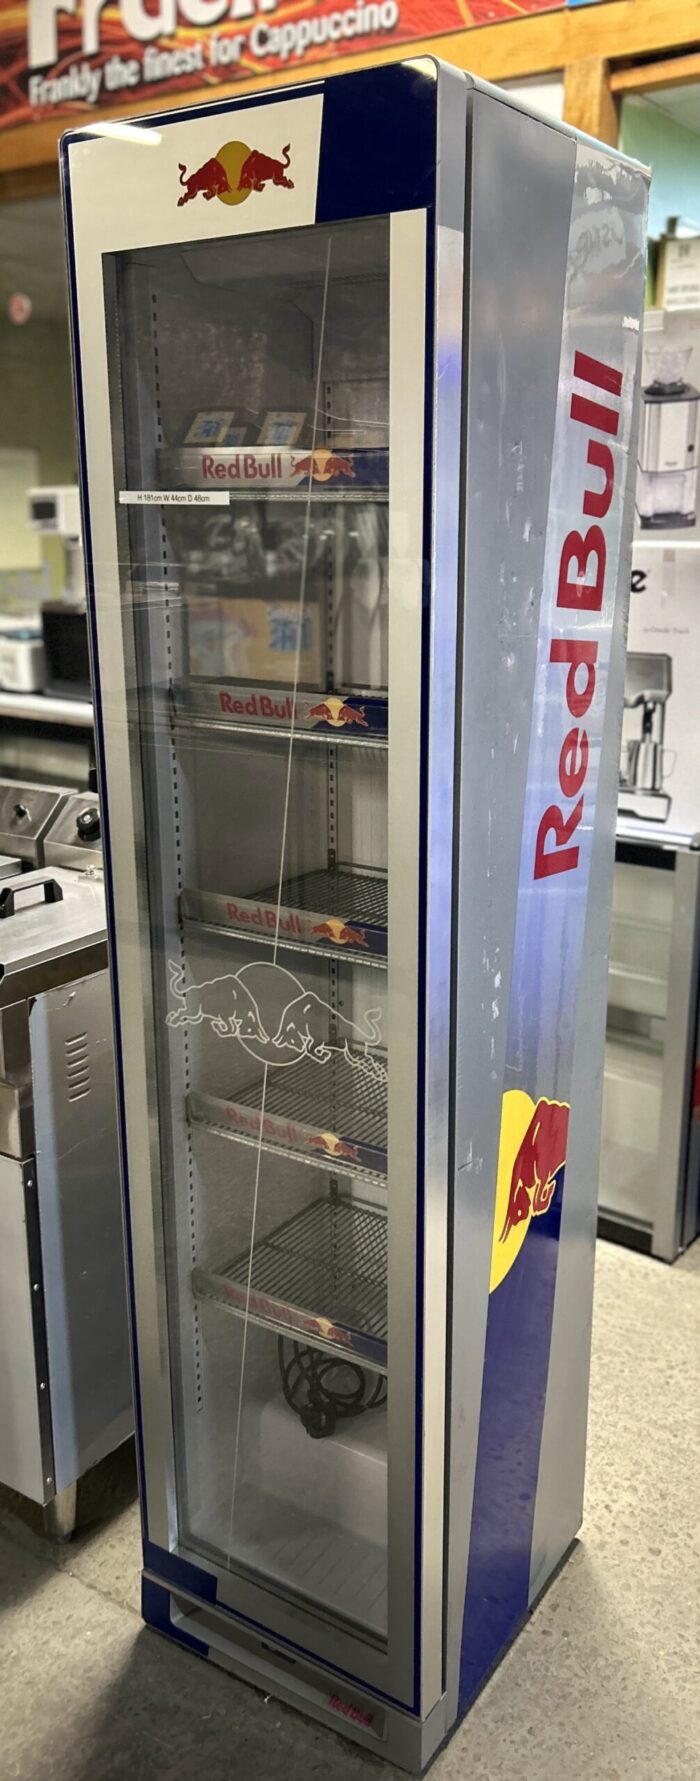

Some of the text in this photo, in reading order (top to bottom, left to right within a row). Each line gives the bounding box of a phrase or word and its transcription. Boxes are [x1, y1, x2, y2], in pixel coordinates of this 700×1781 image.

[28, 60, 102, 107] Frankly
[104, 54, 141, 91] the
[143, 43, 204, 82] finest
[209, 31, 245, 66] for
[250, 0, 398, 60] Cappuccino
[202, 452, 282, 479] Red Bull
[534, 350, 623, 880] Red Bull
[219, 692, 298, 719] Red Bull
[226, 902, 302, 933] Red Bull
